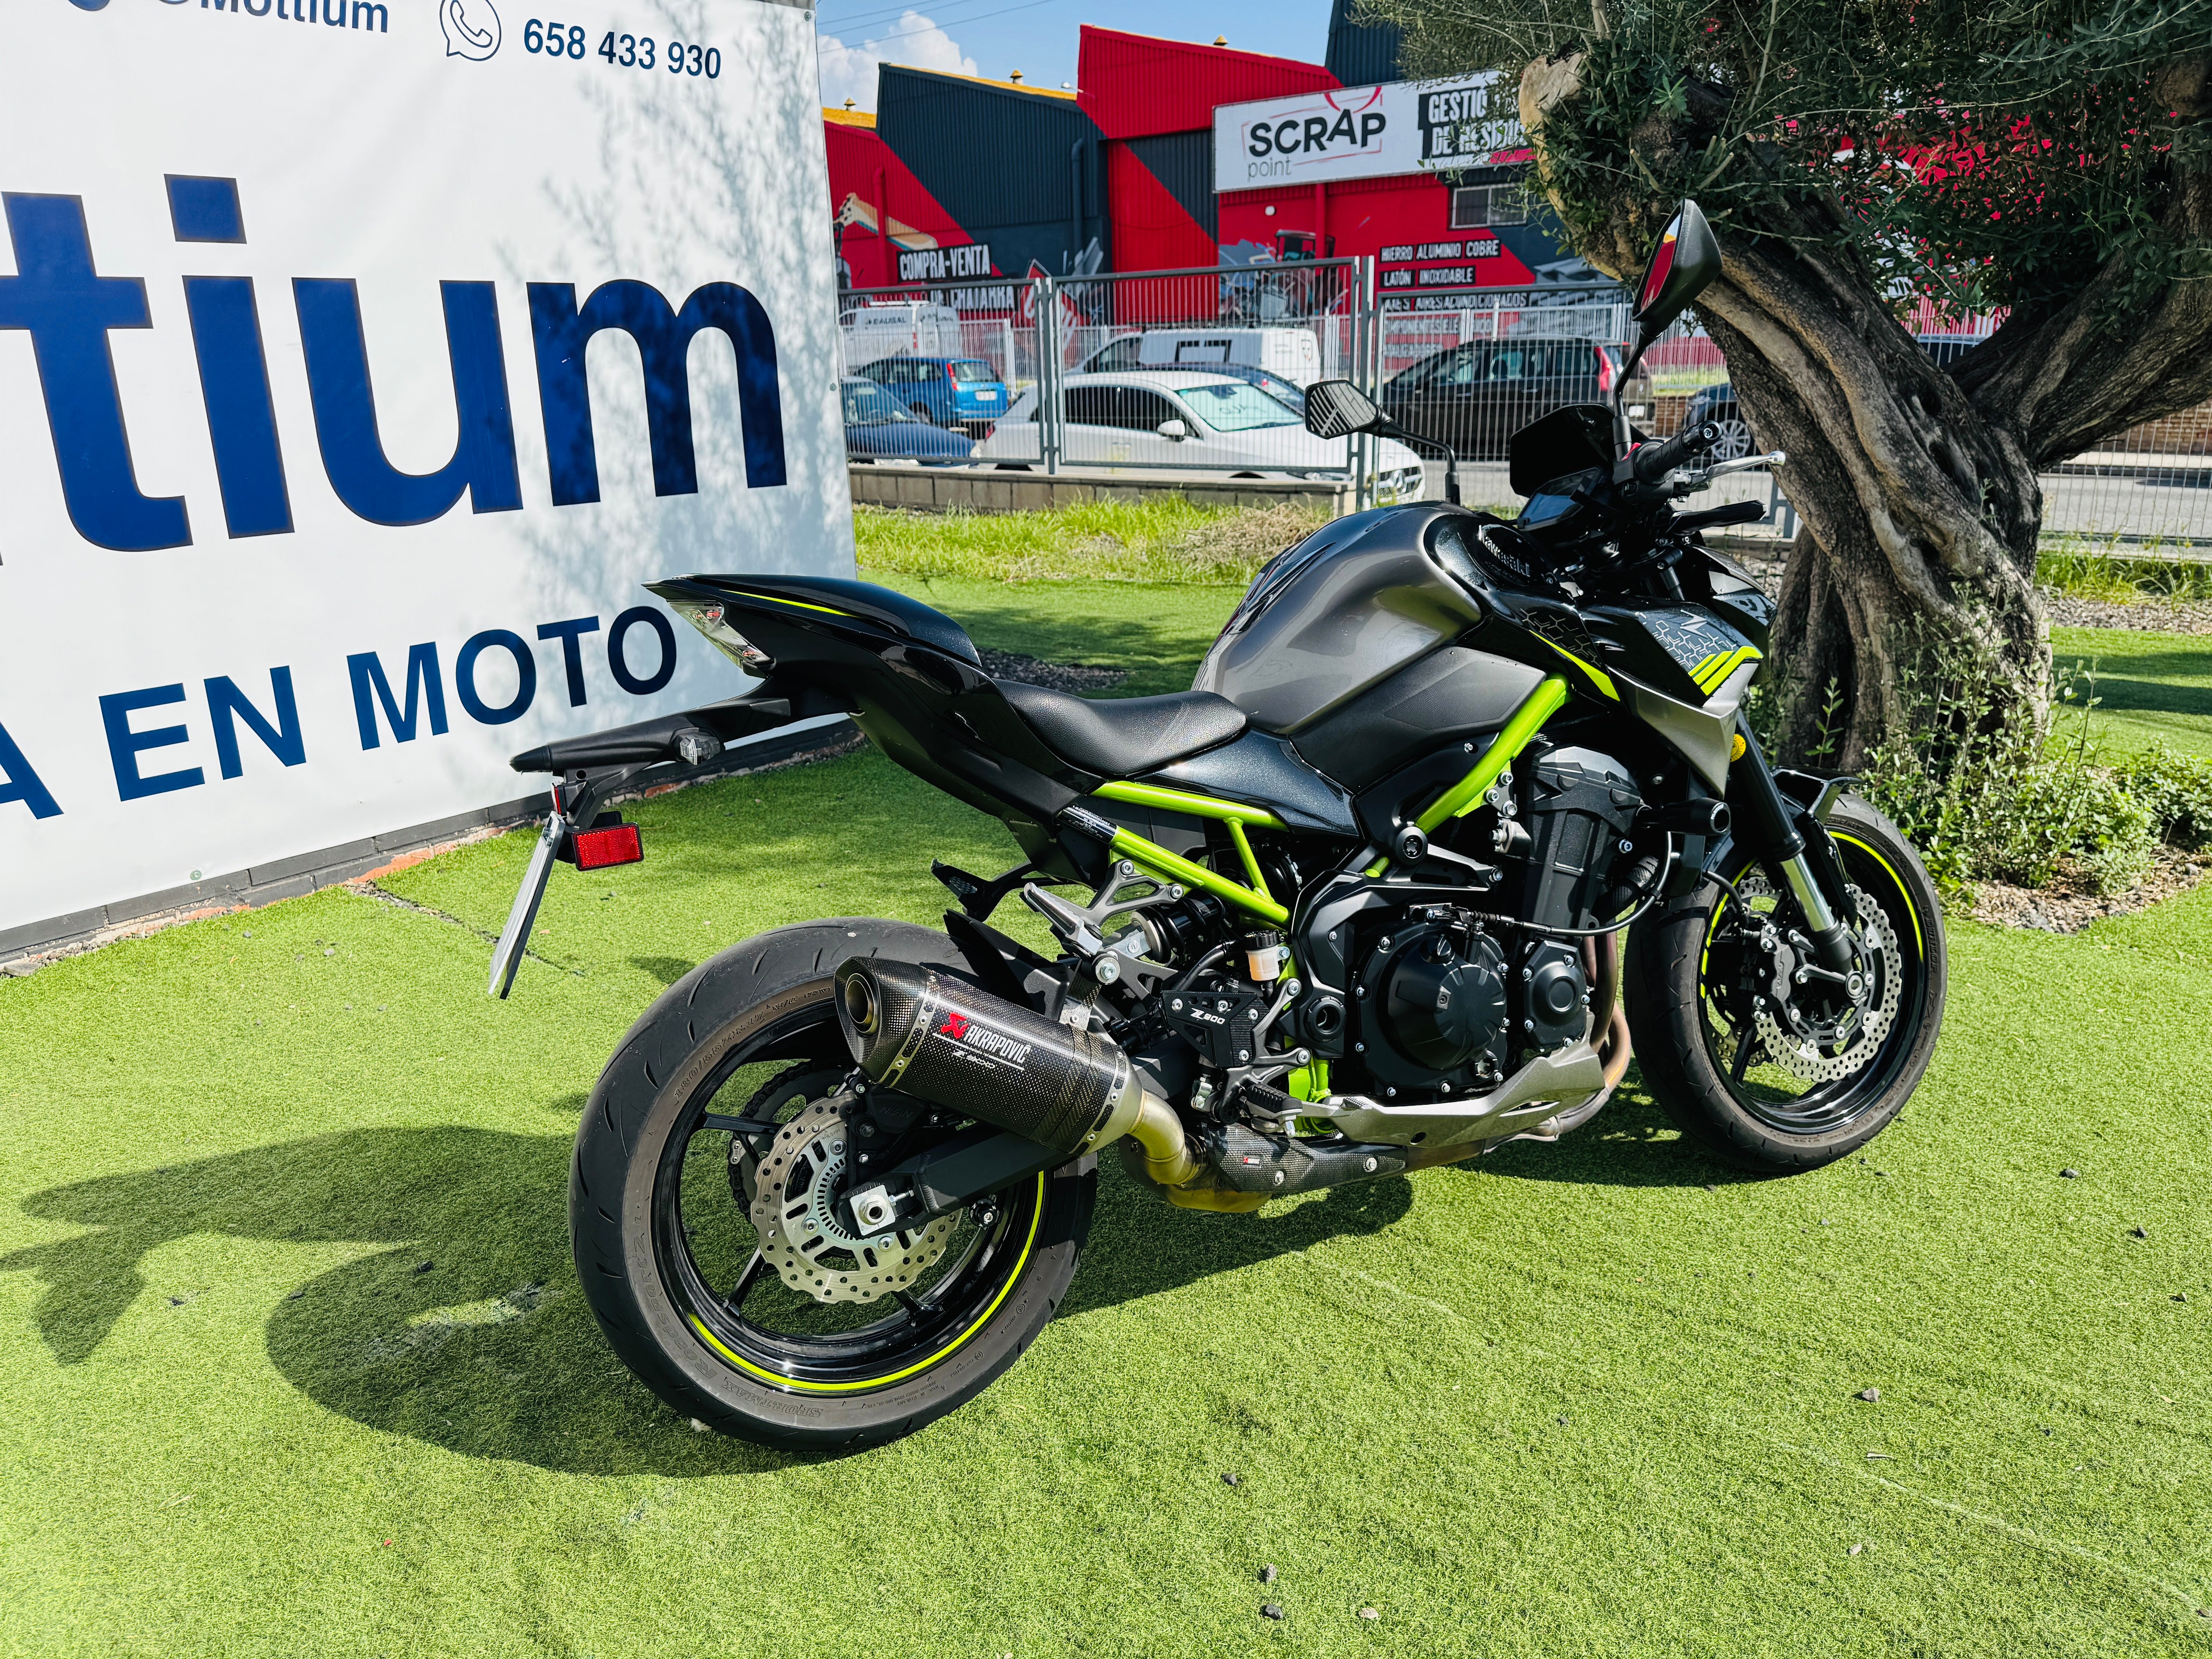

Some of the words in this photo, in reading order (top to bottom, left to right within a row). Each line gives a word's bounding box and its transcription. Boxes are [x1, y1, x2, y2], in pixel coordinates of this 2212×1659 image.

[201, 0, 387, 33] ottium
[524, 19, 585, 59] 658
[598, 32, 655, 69] 433
[668, 42, 721, 79] 930
[1249, 109, 1386, 157] SCRAP
[1432, 125, 1452, 155] DE
[1247, 156, 1292, 182] point
[900, 244, 991, 280] COMPRA-VENTA
[1381, 246, 1413, 262] HIERRO
[1416, 243, 1462, 259] ALUMINIO
[1466, 240, 1500, 257] COBRE
[1419, 267, 1474, 285] INOXIDABLE
[98, 665, 307, 802] EN
[346, 605, 678, 751] MOTO
[1190, 1008, 1226, 1025] Z900
[721, 1380, 823, 1418] SPORTMAX
